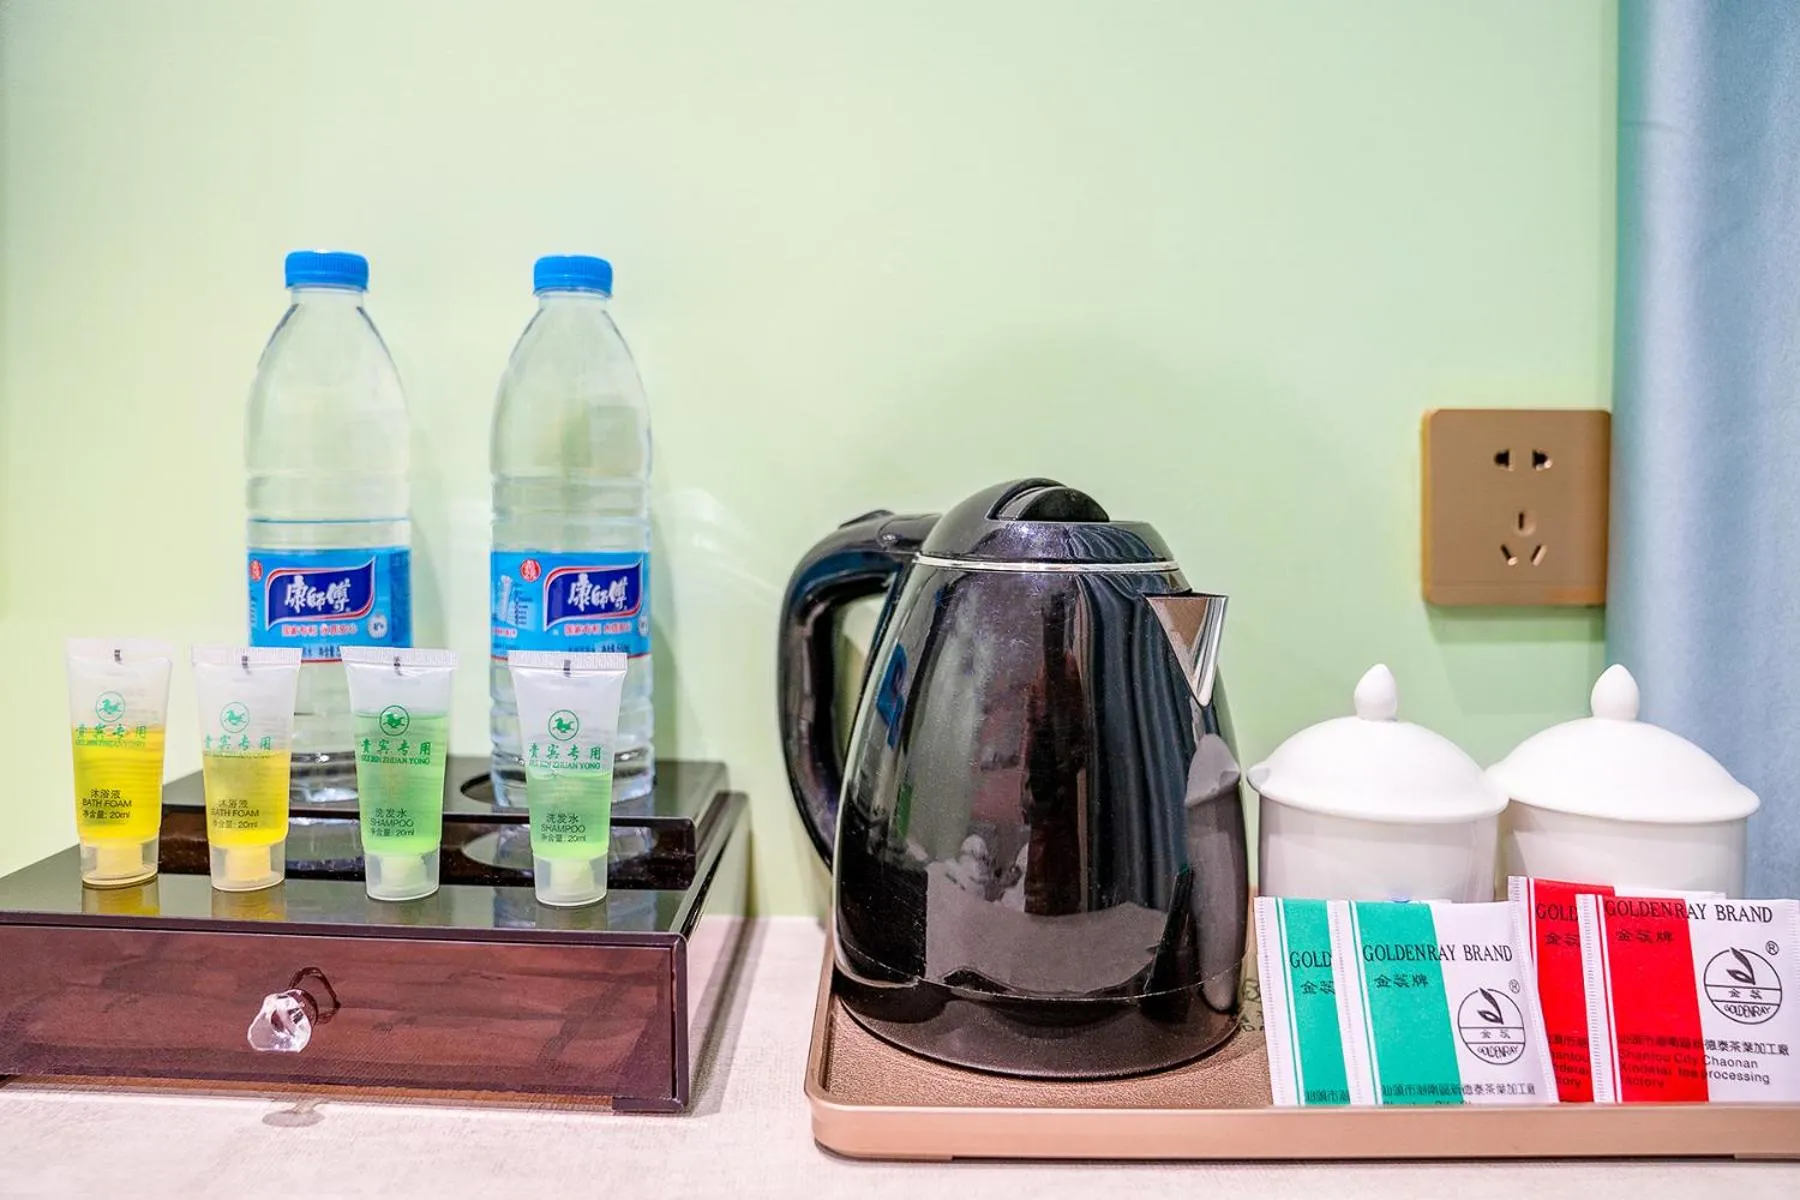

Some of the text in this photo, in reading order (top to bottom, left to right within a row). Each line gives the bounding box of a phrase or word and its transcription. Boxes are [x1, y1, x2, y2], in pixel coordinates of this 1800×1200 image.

[82, 798, 132, 808] BATH FOAM
[109, 810, 130, 819] 20ml
[232, 809, 260, 817] FOAM
[238, 820, 258, 829] 20ml
[370, 818, 414, 828] SHAMPOO
[395, 828, 414, 837] 20ml
[541, 823, 586, 834] SHAMPOO
[567, 834, 586, 843] 20ml
[1605, 900, 1773, 923] GOLDENRAY BRAND
[1363, 945, 1513, 962] GOLDENRAY BRAND
[1289, 951, 1332, 968] GOLD
[1704, 1055, 1759, 1070] Chaonan
